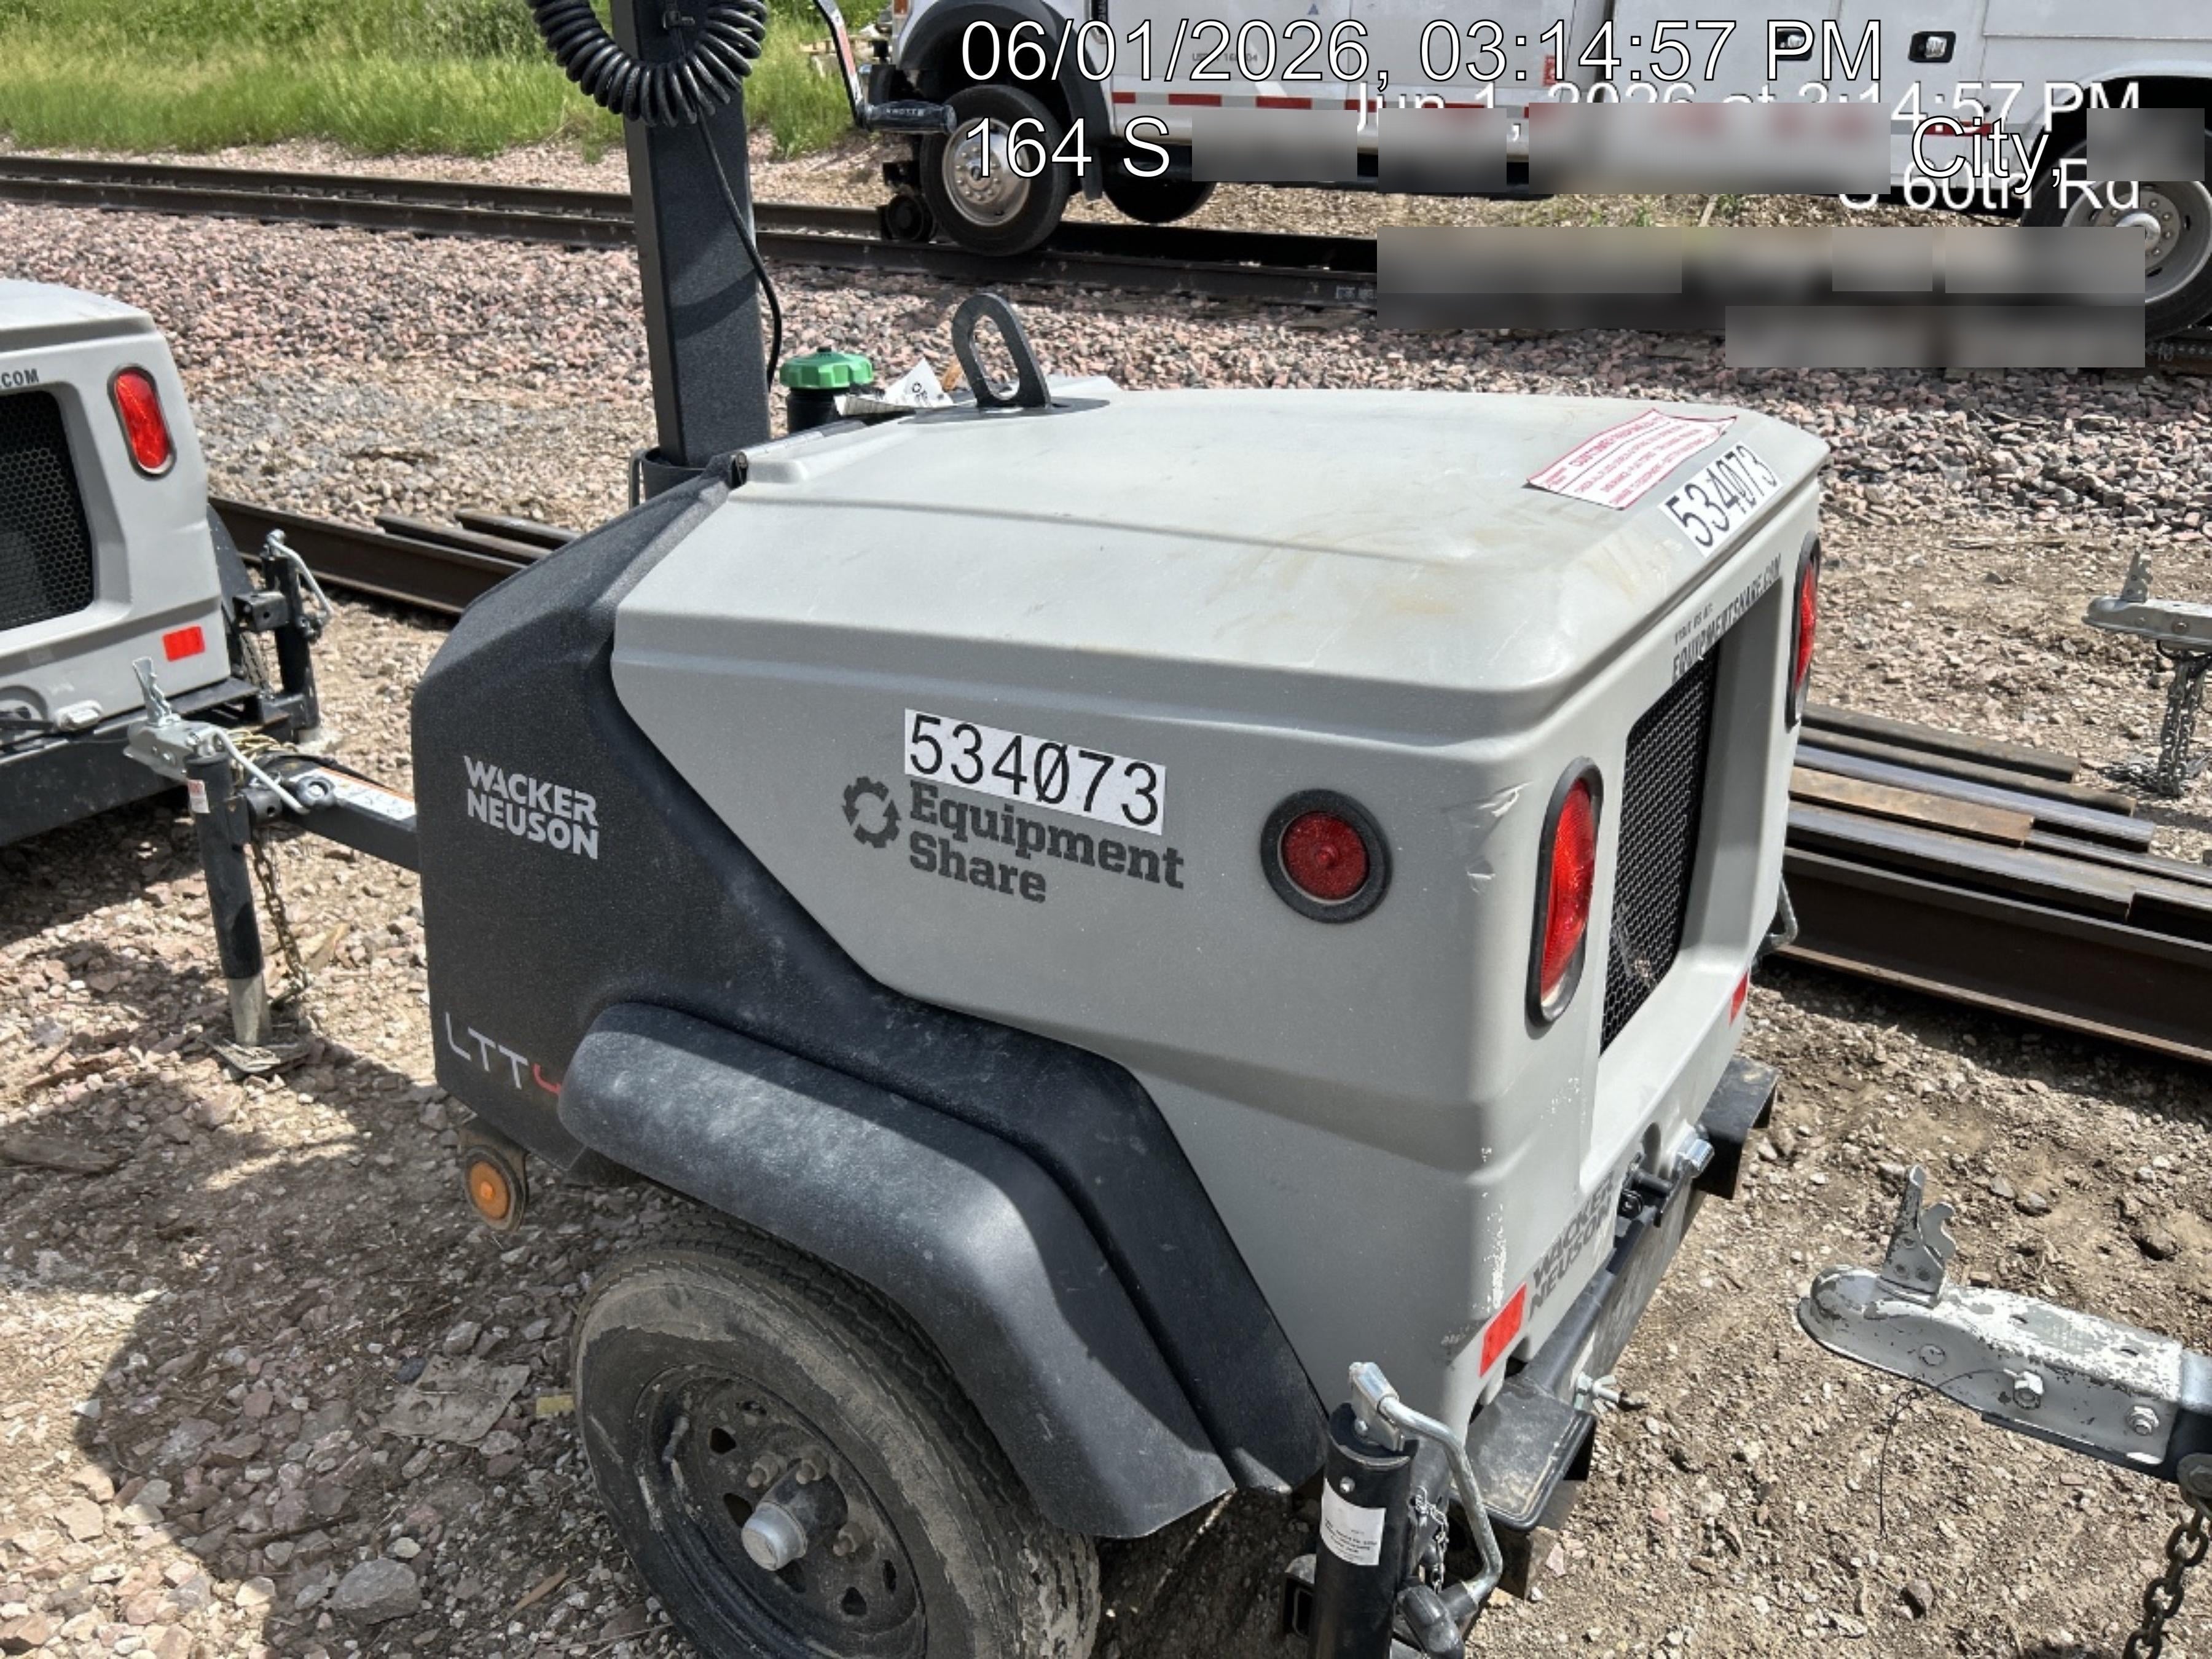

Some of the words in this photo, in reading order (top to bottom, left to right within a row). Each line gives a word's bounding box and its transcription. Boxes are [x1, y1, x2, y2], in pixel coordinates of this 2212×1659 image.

[1665, 445, 1778, 547] 534073
[463, 755, 599, 827] WACKER
[909, 713, 1158, 826] 534073
[467, 788, 599, 860] NEUSON
[909, 780, 1184, 888] Equipment
[909, 831, 1046, 903] Share
